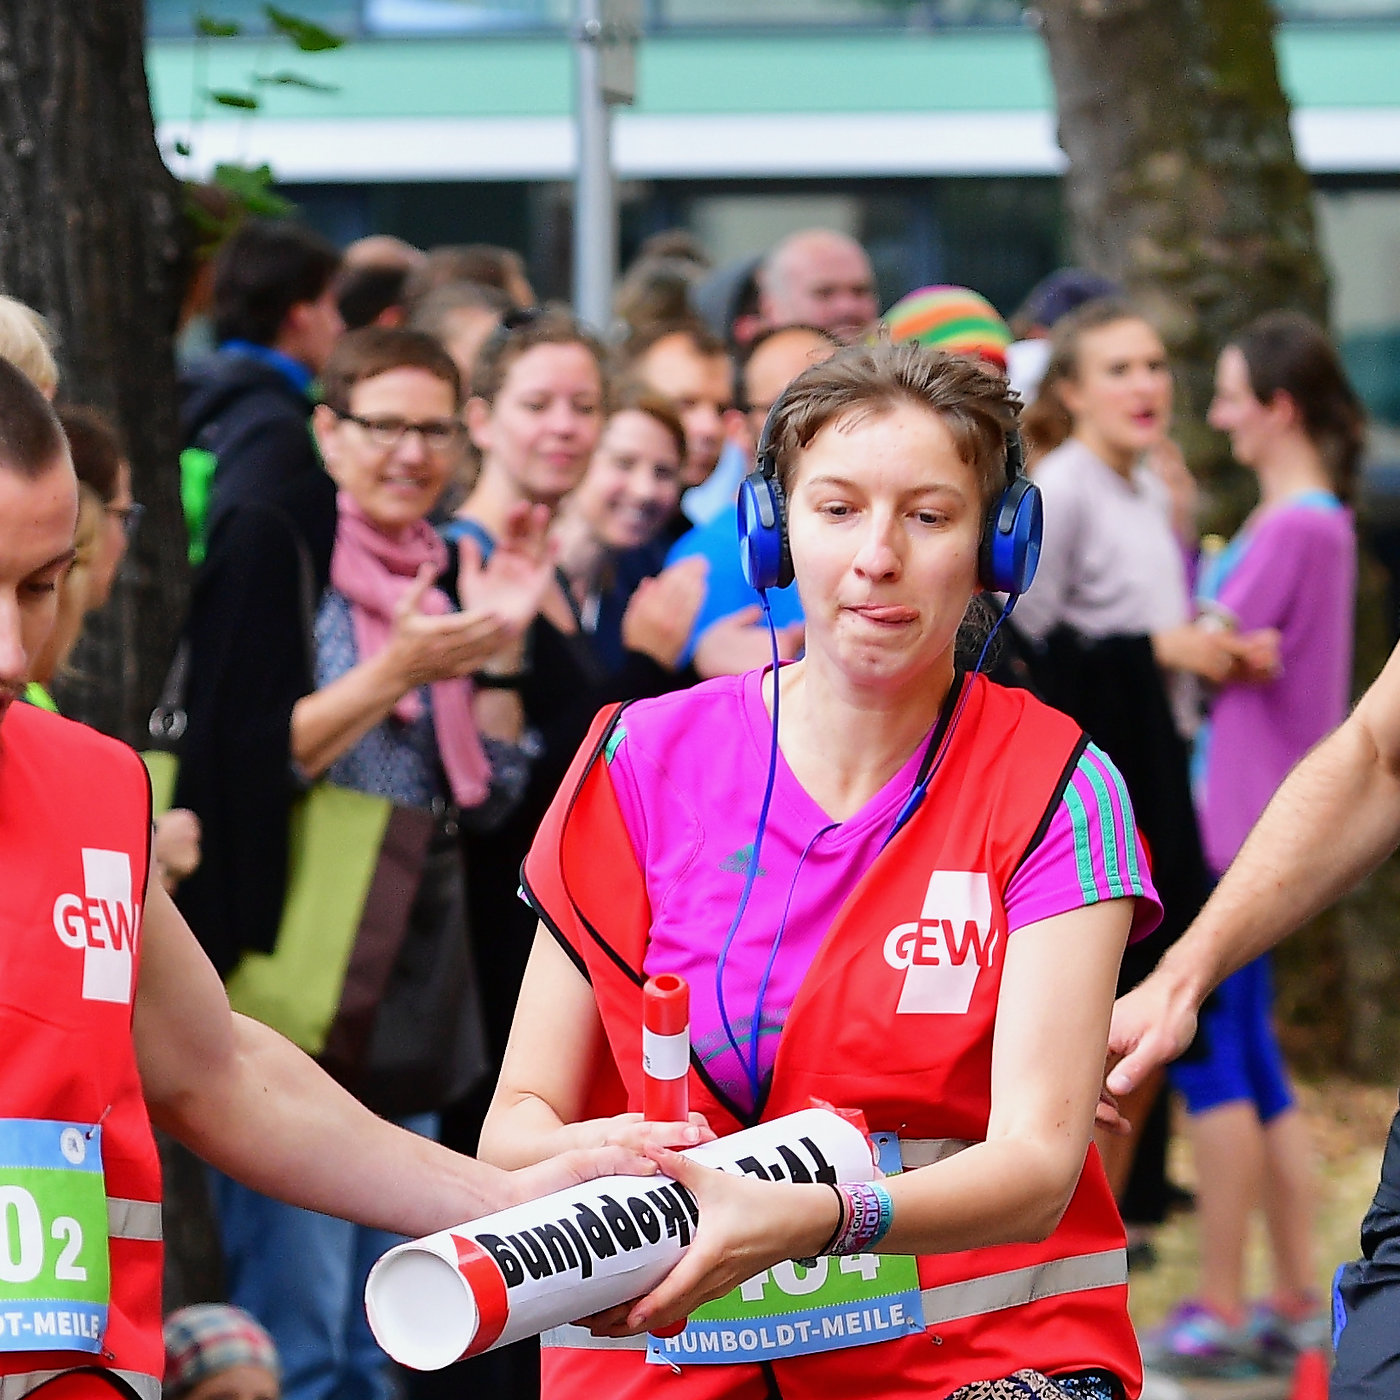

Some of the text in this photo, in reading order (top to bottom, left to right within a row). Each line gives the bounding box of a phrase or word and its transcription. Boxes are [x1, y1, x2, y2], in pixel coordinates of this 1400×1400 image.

[53, 893, 141, 956] GEW
[883, 917, 999, 970] GEW
[664, 1303, 906, 1353] HUMBOLDT-MEILE
